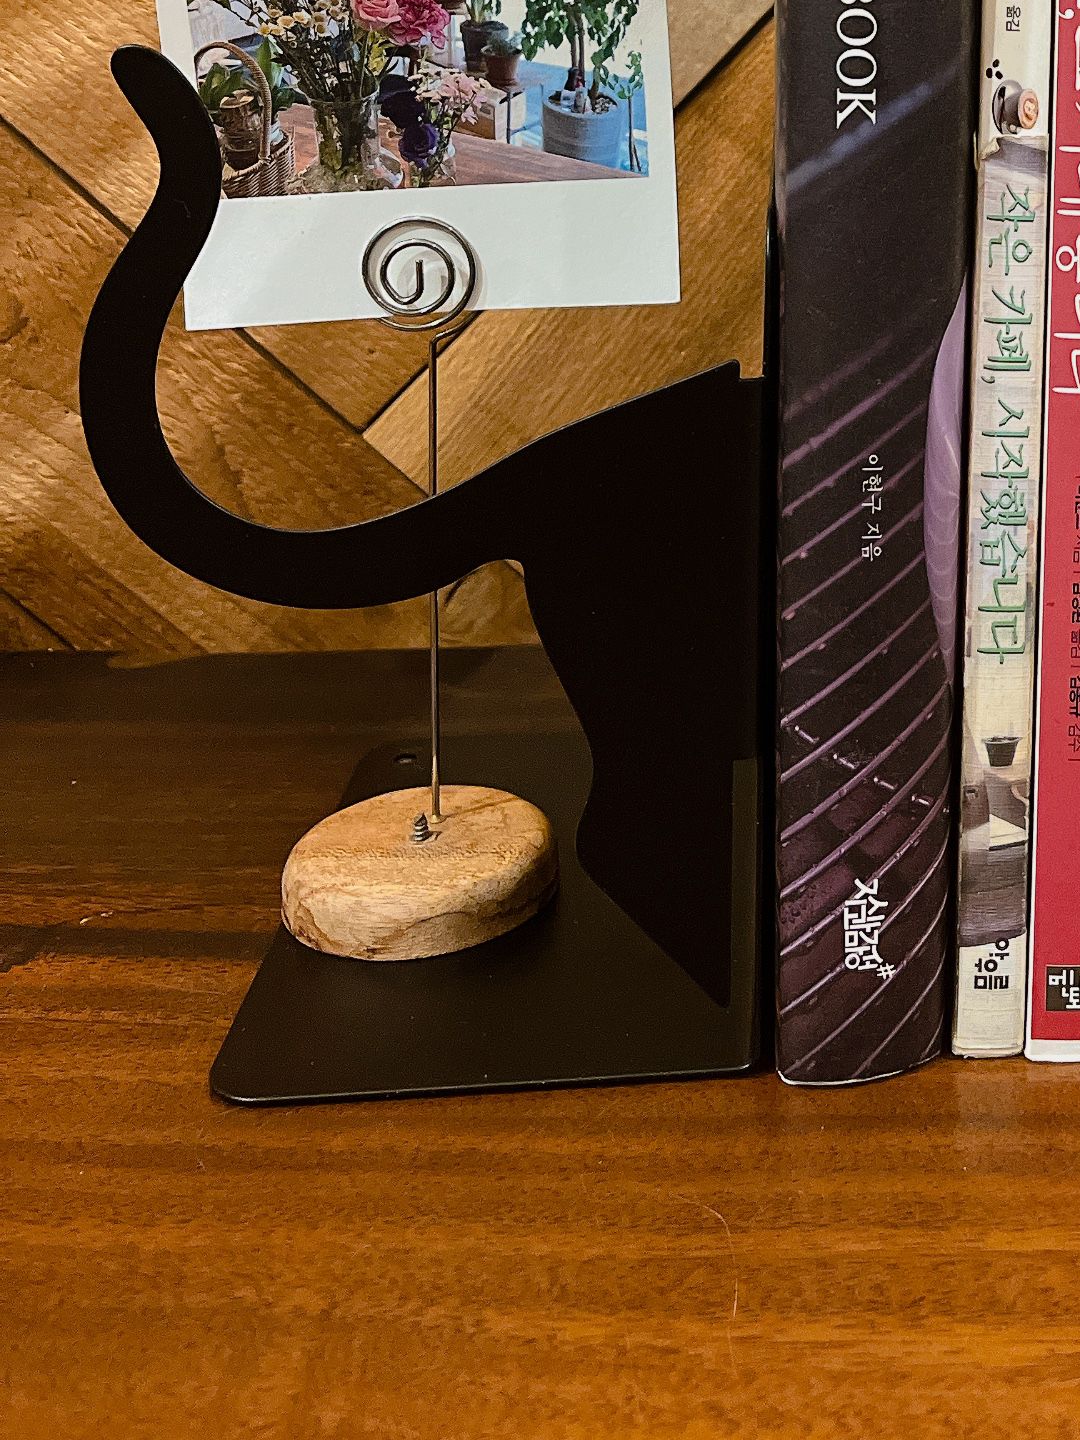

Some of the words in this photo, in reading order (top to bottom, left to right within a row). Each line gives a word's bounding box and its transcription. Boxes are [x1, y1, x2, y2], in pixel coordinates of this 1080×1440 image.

[1005, 6, 1022, 33] 옮김
[986, 183, 1035, 276] 작은
[981, 285, 1034, 384] 카페,
[861, 454, 884, 514] 이현구
[861, 522, 883, 562] 지음
[976, 399, 1030, 665] 시작했습니다
